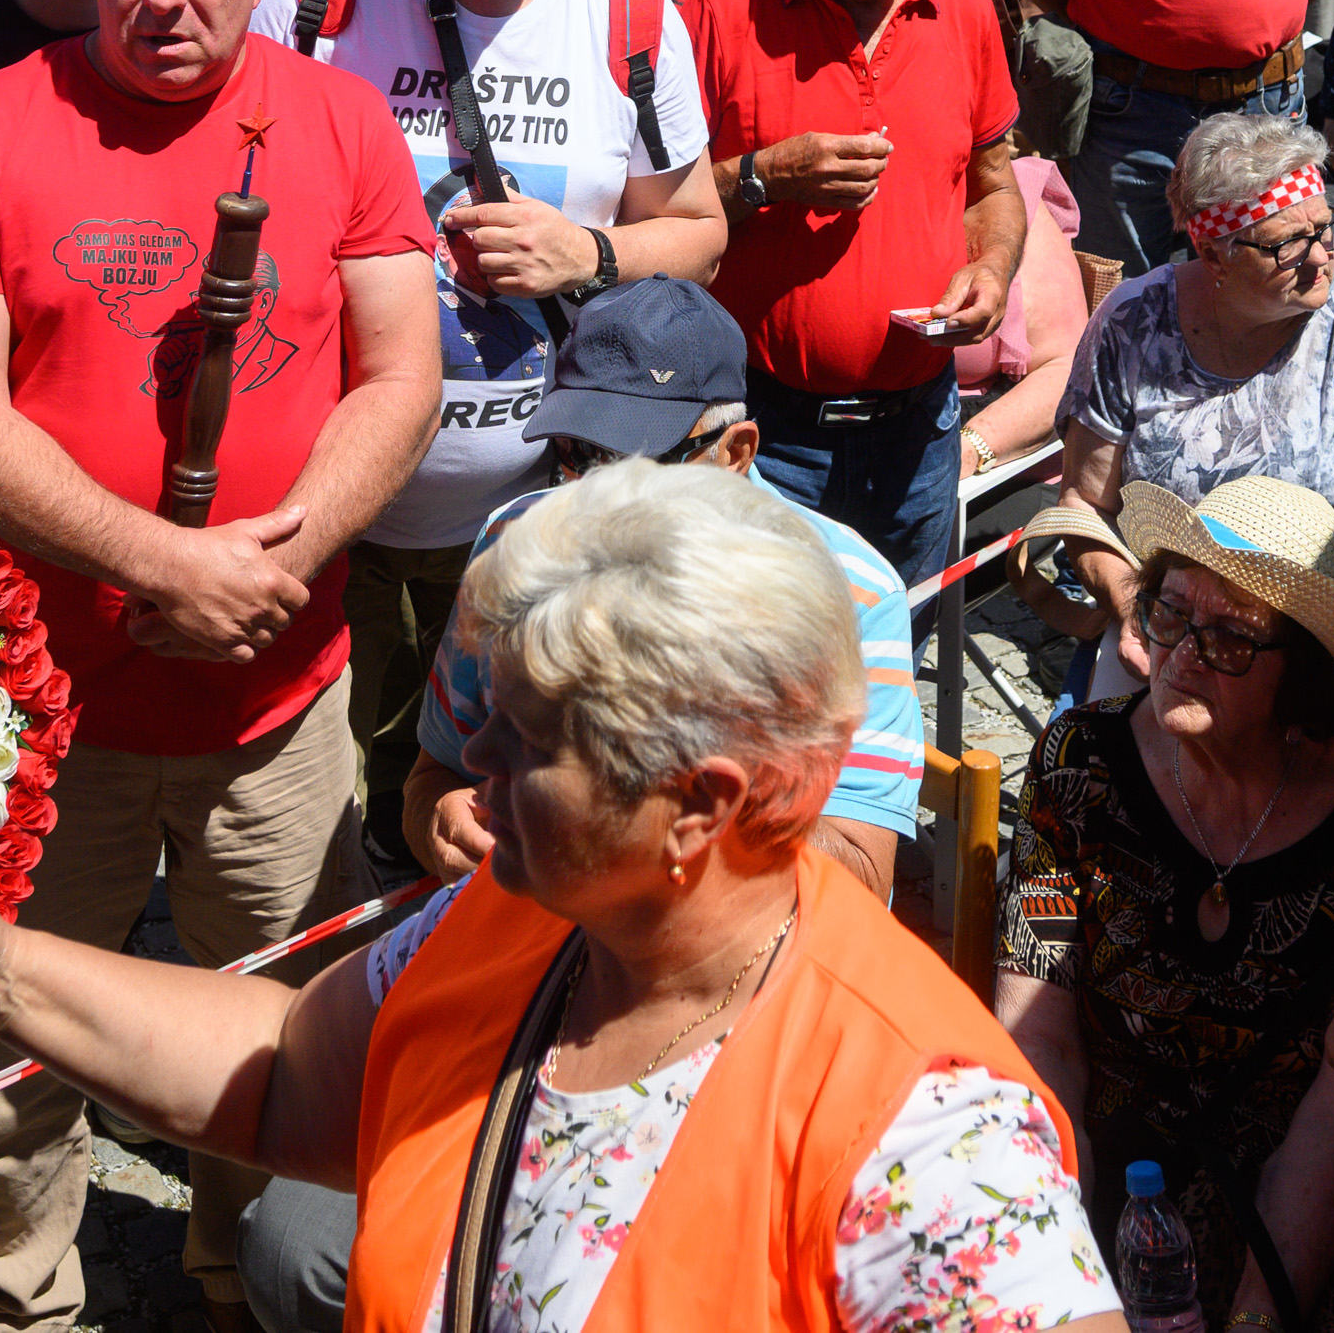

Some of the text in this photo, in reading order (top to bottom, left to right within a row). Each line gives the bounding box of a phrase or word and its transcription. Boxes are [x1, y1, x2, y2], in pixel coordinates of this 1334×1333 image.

[389, 66, 571, 108] DRŠTVO
[454, 113, 516, 143] OZ
[522, 115, 569, 146] TITO
[75, 233, 183, 248] SAMO VAS GLEDAM
[82, 249, 173, 266] MAJKU VAM
[103, 265, 157, 286] BOŽJU
[440, 386, 542, 429] REČ
